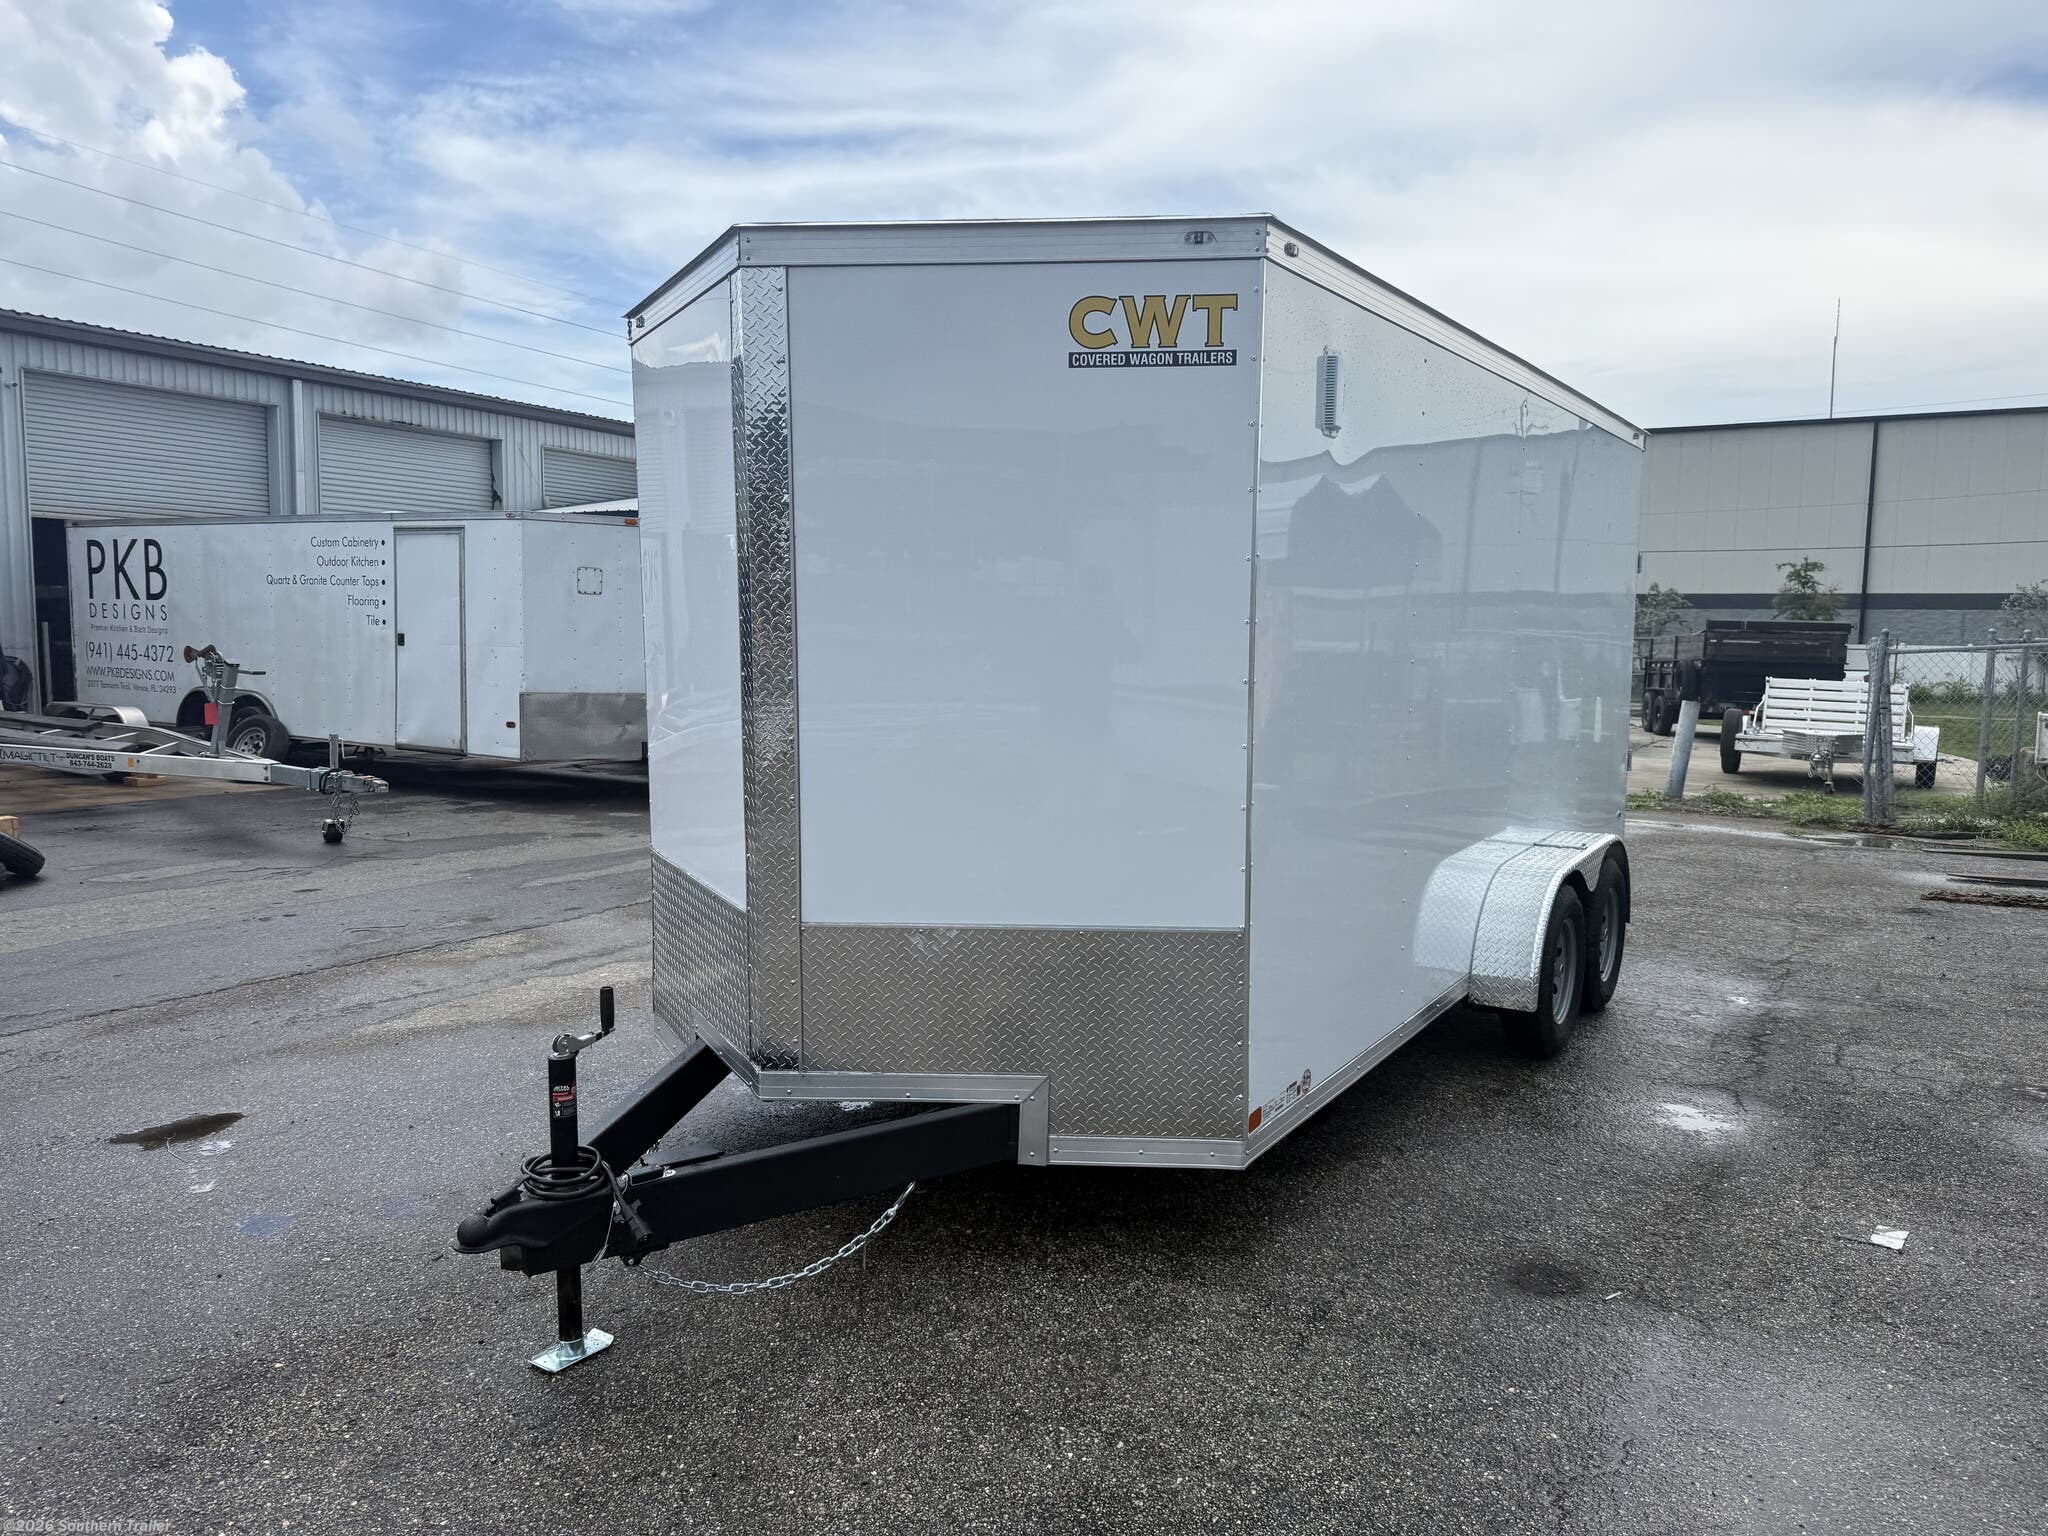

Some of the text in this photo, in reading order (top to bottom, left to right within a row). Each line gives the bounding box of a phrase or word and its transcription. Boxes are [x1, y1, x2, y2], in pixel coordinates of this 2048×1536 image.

[1069, 293, 1238, 349] CWT
[1072, 352, 1233, 366] COVERED WAGON TRAILERS
[310, 536, 379, 549] Custom Cabinetry
[316, 555, 379, 567] Outdoor Kitchen
[86, 539, 167, 600] PKB
[266, 575, 379, 588] Quartz & Granite Counter Tops
[347, 595, 379, 609] Flooring
[89, 602, 167, 621] DESIGNS
[366, 615, 380, 625] Tile
[86, 641, 174, 662] (941) 445-4372
[86, 665, 175, 682] WWW.PKBDESIGNS.COM
[66, 752, 95, 760] DUNCAN'S
